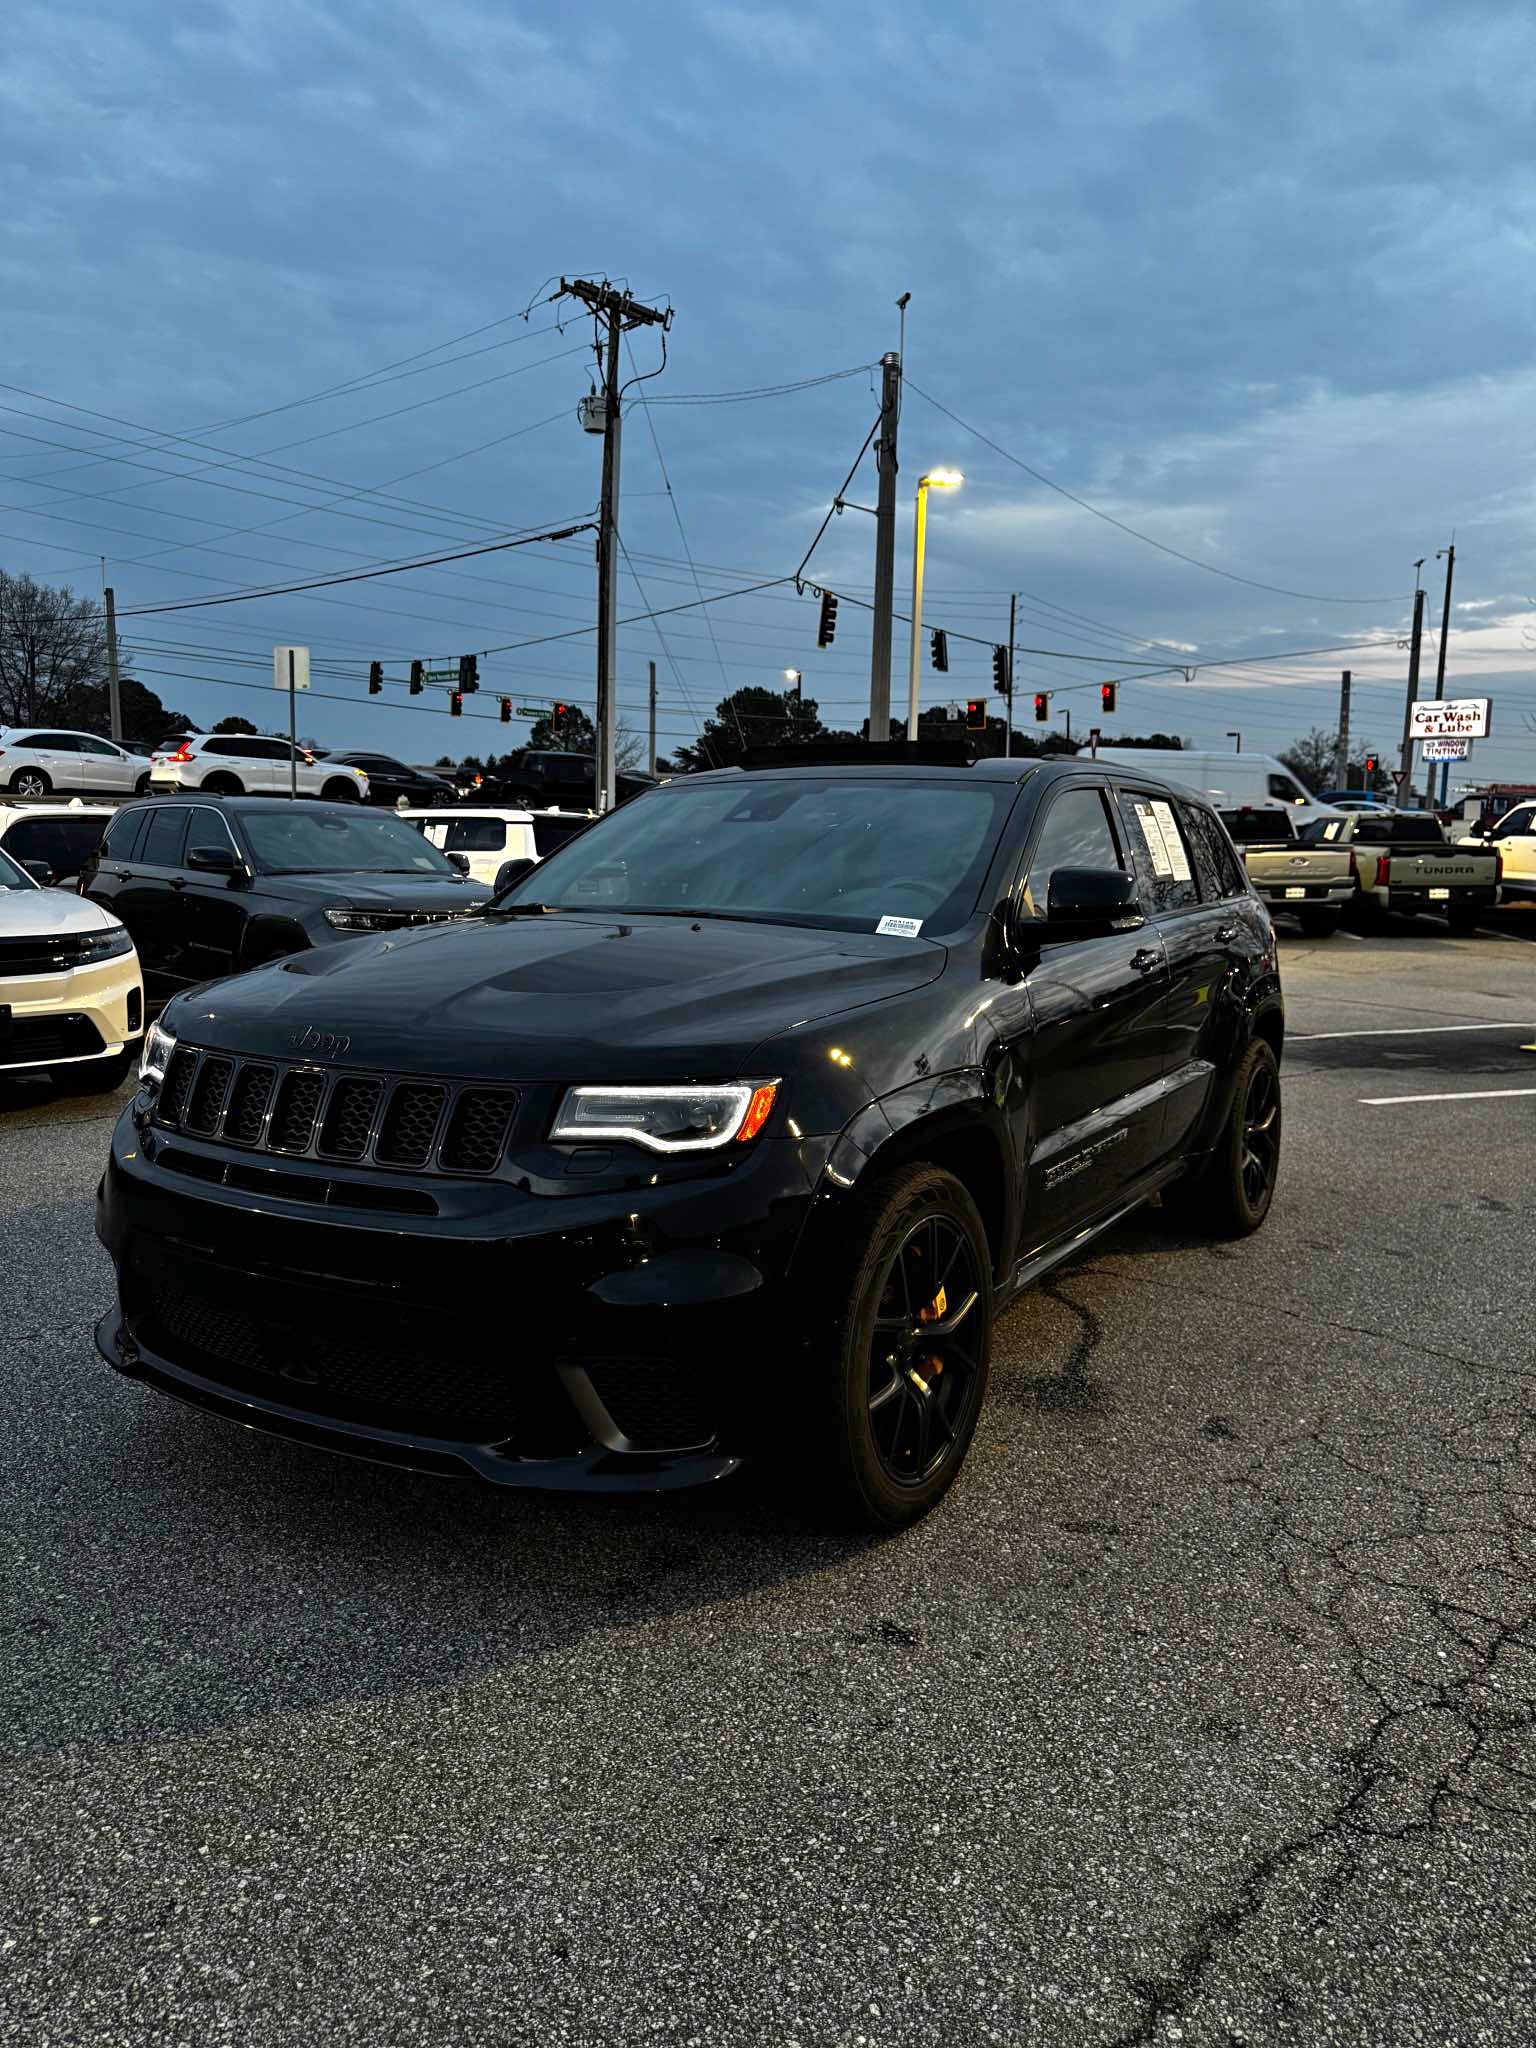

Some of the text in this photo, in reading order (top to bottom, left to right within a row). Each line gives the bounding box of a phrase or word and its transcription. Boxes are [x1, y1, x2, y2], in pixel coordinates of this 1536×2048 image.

[1415, 711, 1481, 723] Car Wash
[1424, 721, 1473, 733] & Lube
[1426, 747, 1465, 755] TINTING
[1415, 865, 1475, 875] TUNDRA
